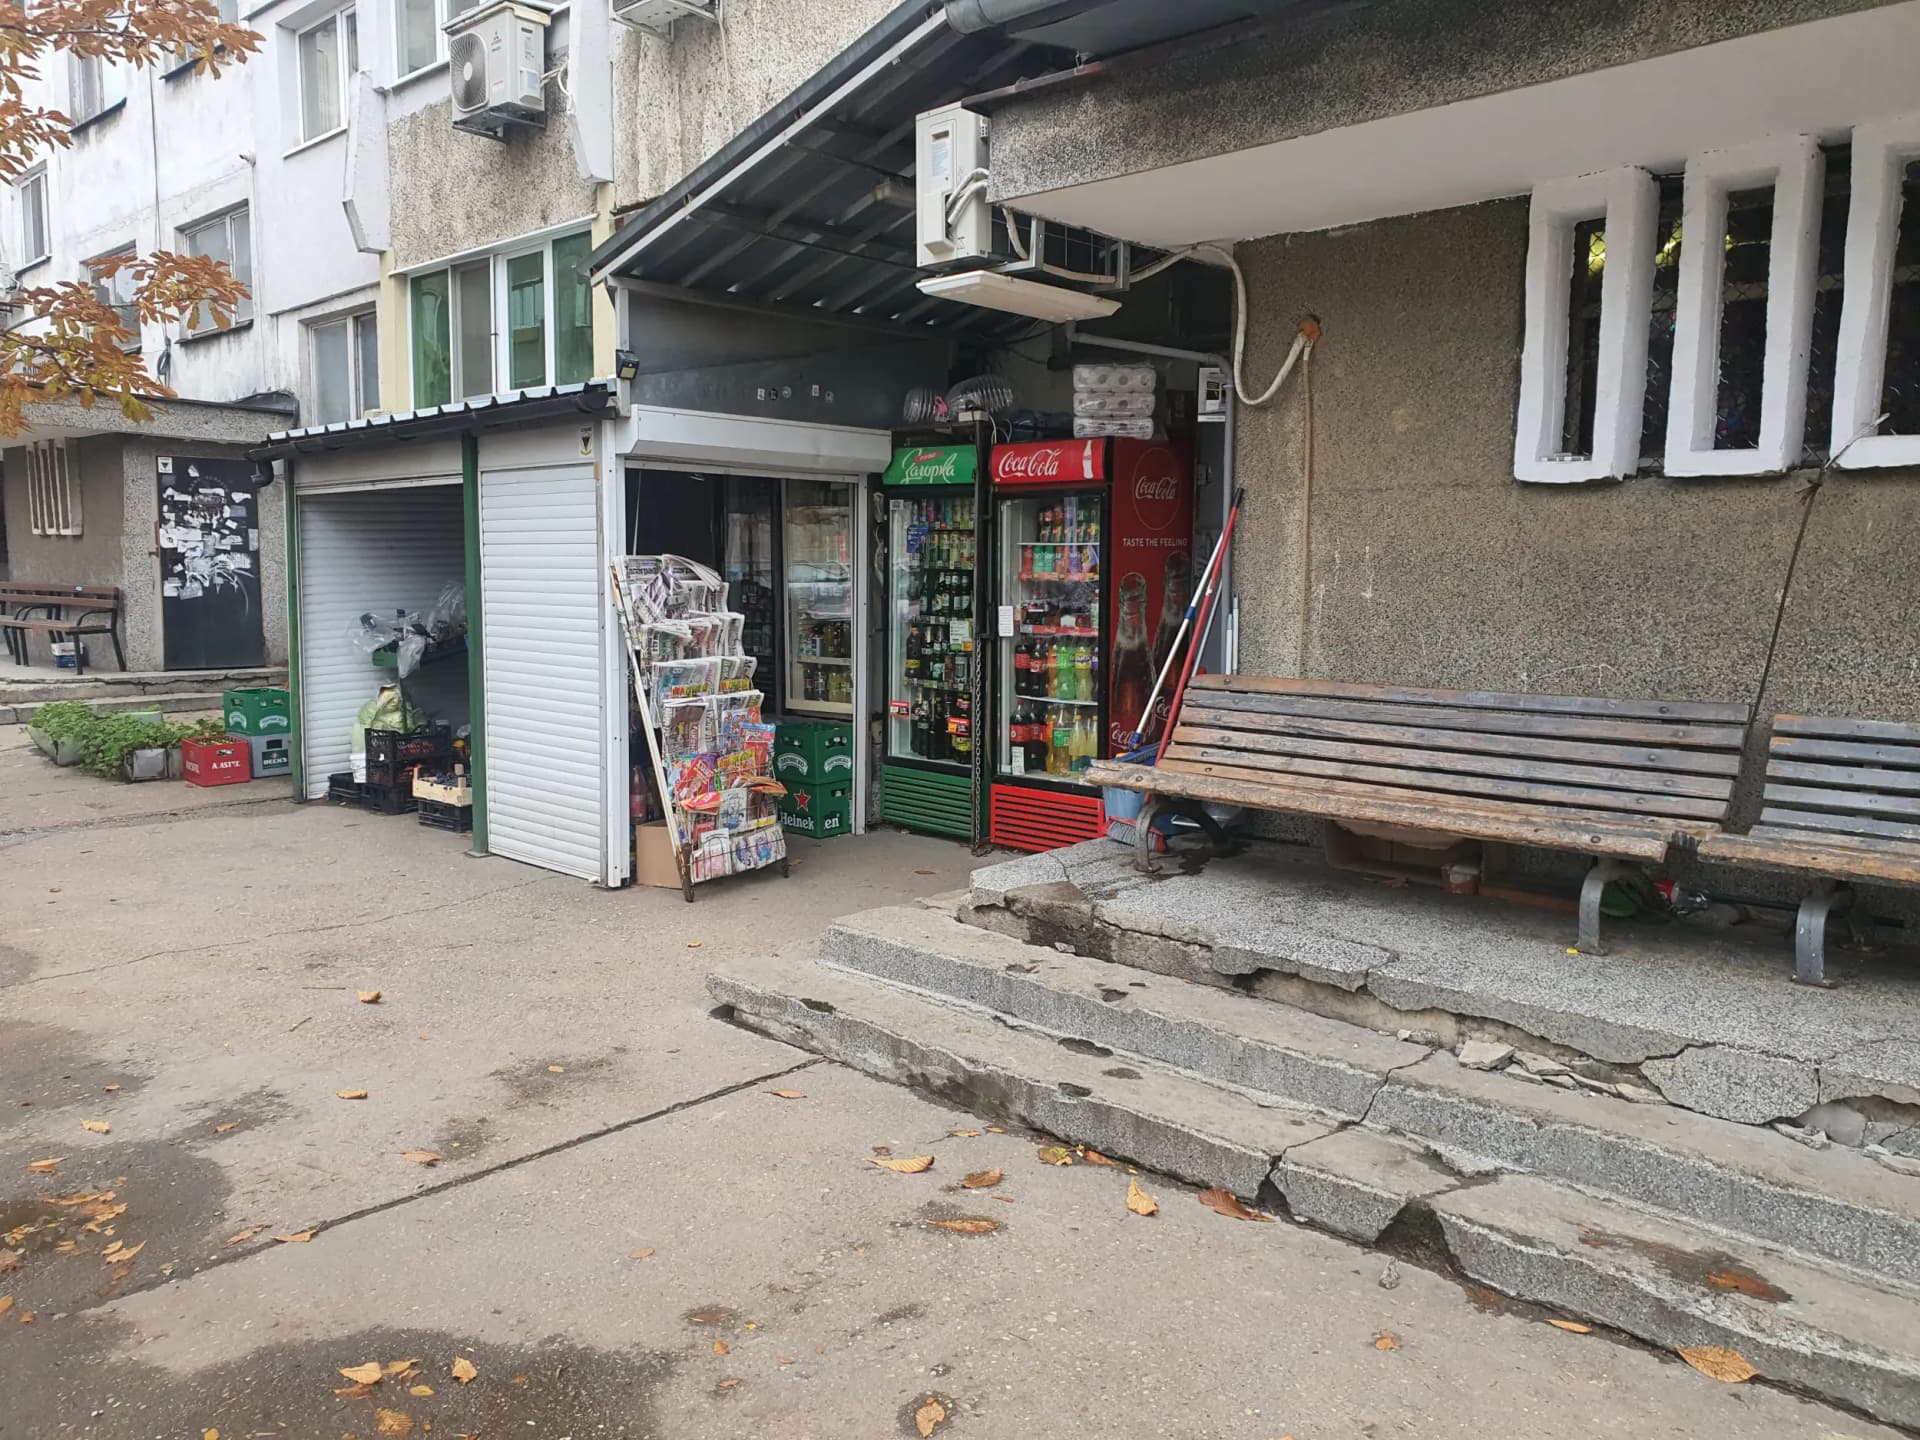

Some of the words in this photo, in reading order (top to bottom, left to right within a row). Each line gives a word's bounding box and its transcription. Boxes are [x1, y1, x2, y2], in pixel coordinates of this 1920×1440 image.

[998, 448, 1063, 479] Coca-Cola
[1122, 537, 1145, 548] TASTE
[1146, 537, 1159, 548] THE
[1160, 537, 1188, 547] FEELING
